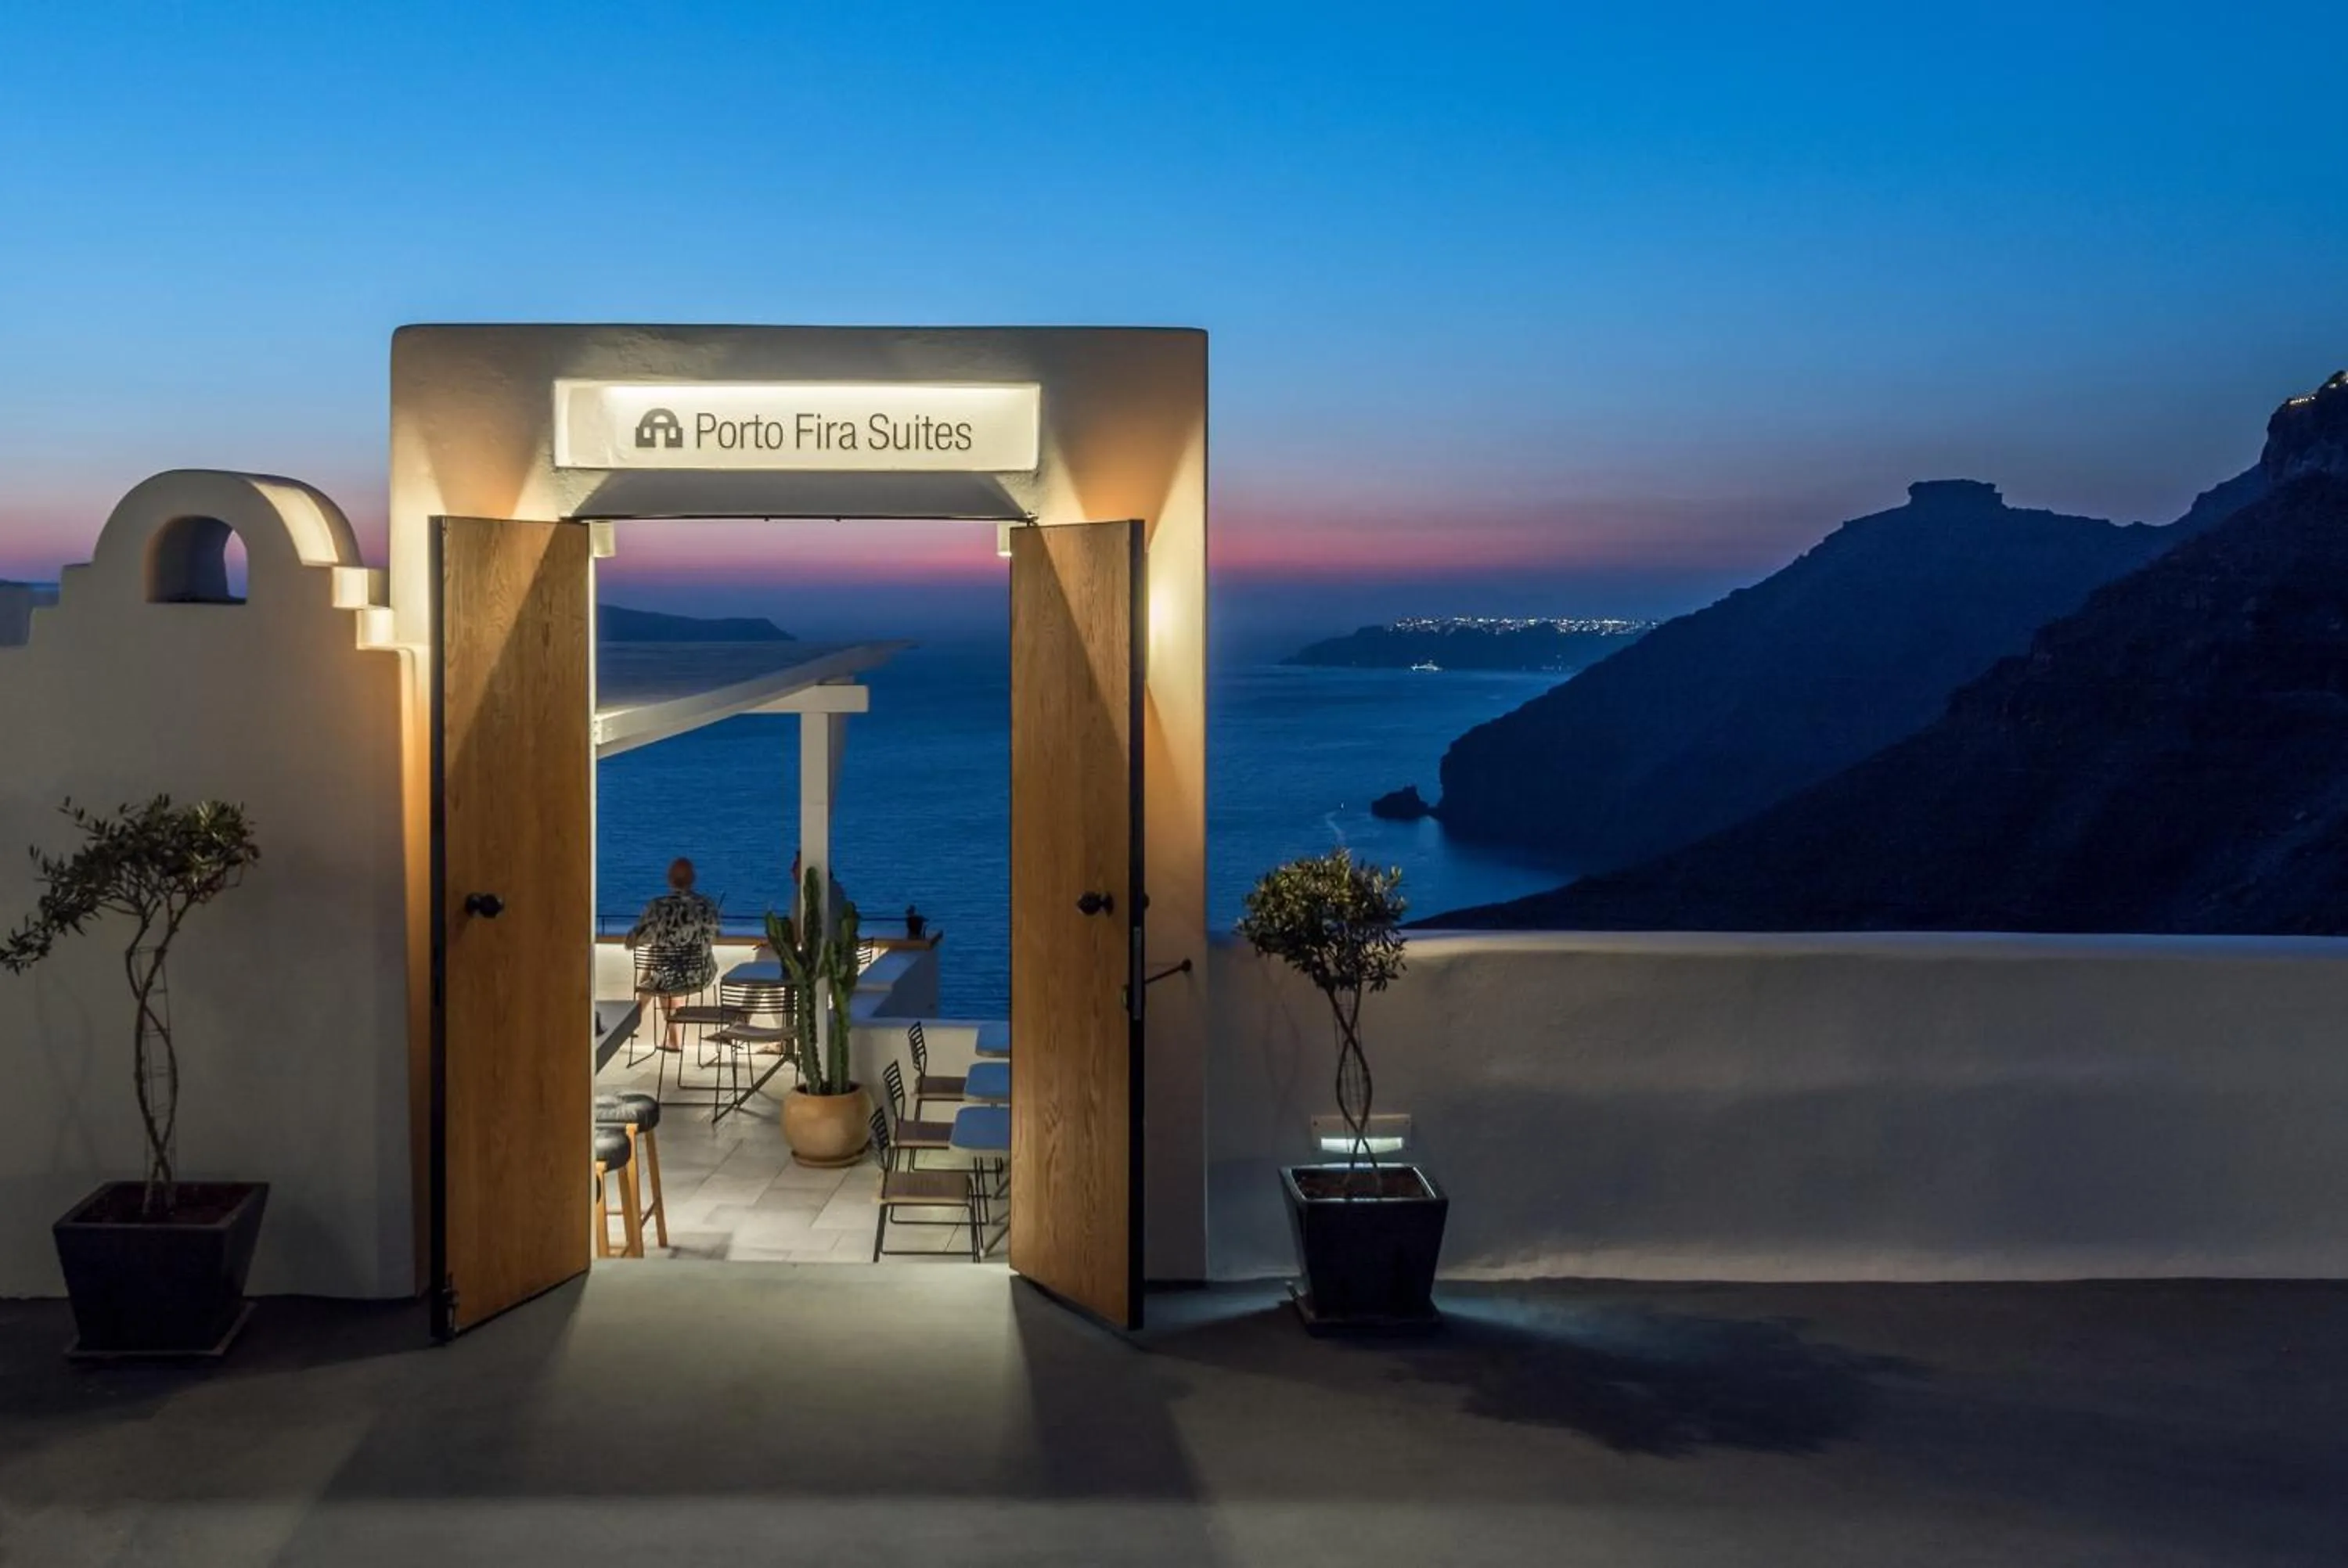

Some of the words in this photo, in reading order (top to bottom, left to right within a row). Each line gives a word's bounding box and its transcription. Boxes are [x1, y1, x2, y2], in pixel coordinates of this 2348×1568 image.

[696, 412, 783, 450] Porto
[795, 413, 858, 450] Fira
[868, 414, 972, 451] Suites
